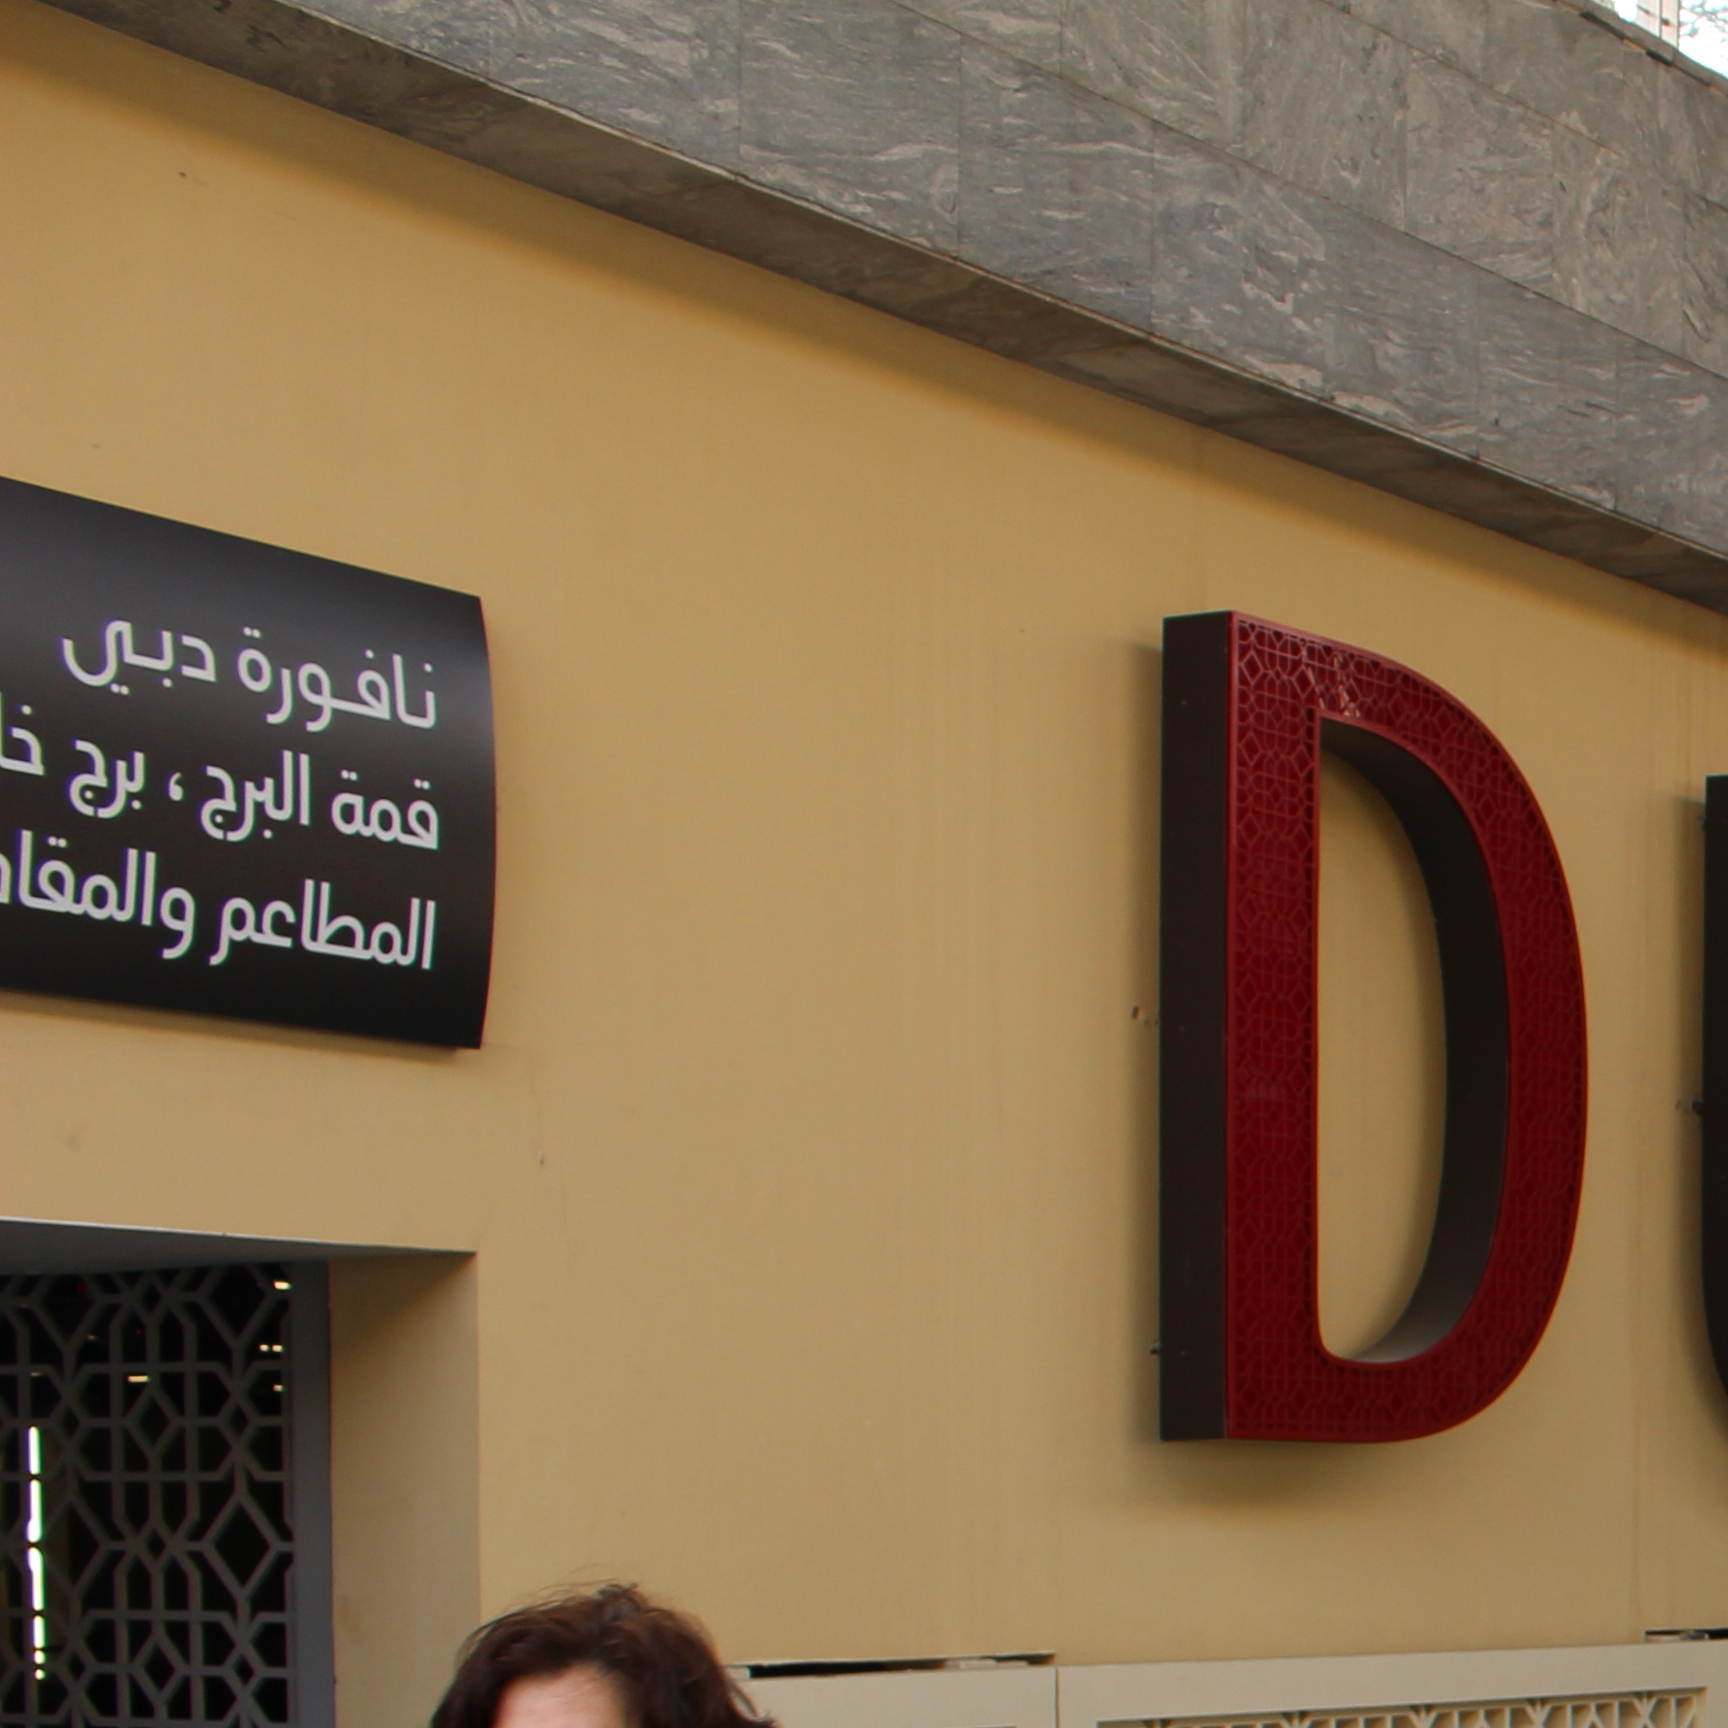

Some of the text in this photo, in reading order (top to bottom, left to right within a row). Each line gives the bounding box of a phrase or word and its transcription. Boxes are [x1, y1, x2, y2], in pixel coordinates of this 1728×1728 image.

[62, 620, 437, 732] نافورة دبي
[69, 739, 146, 818] برج
[331, 769, 439, 850] قمة
[208, 878, 437, 970] المطاعم
